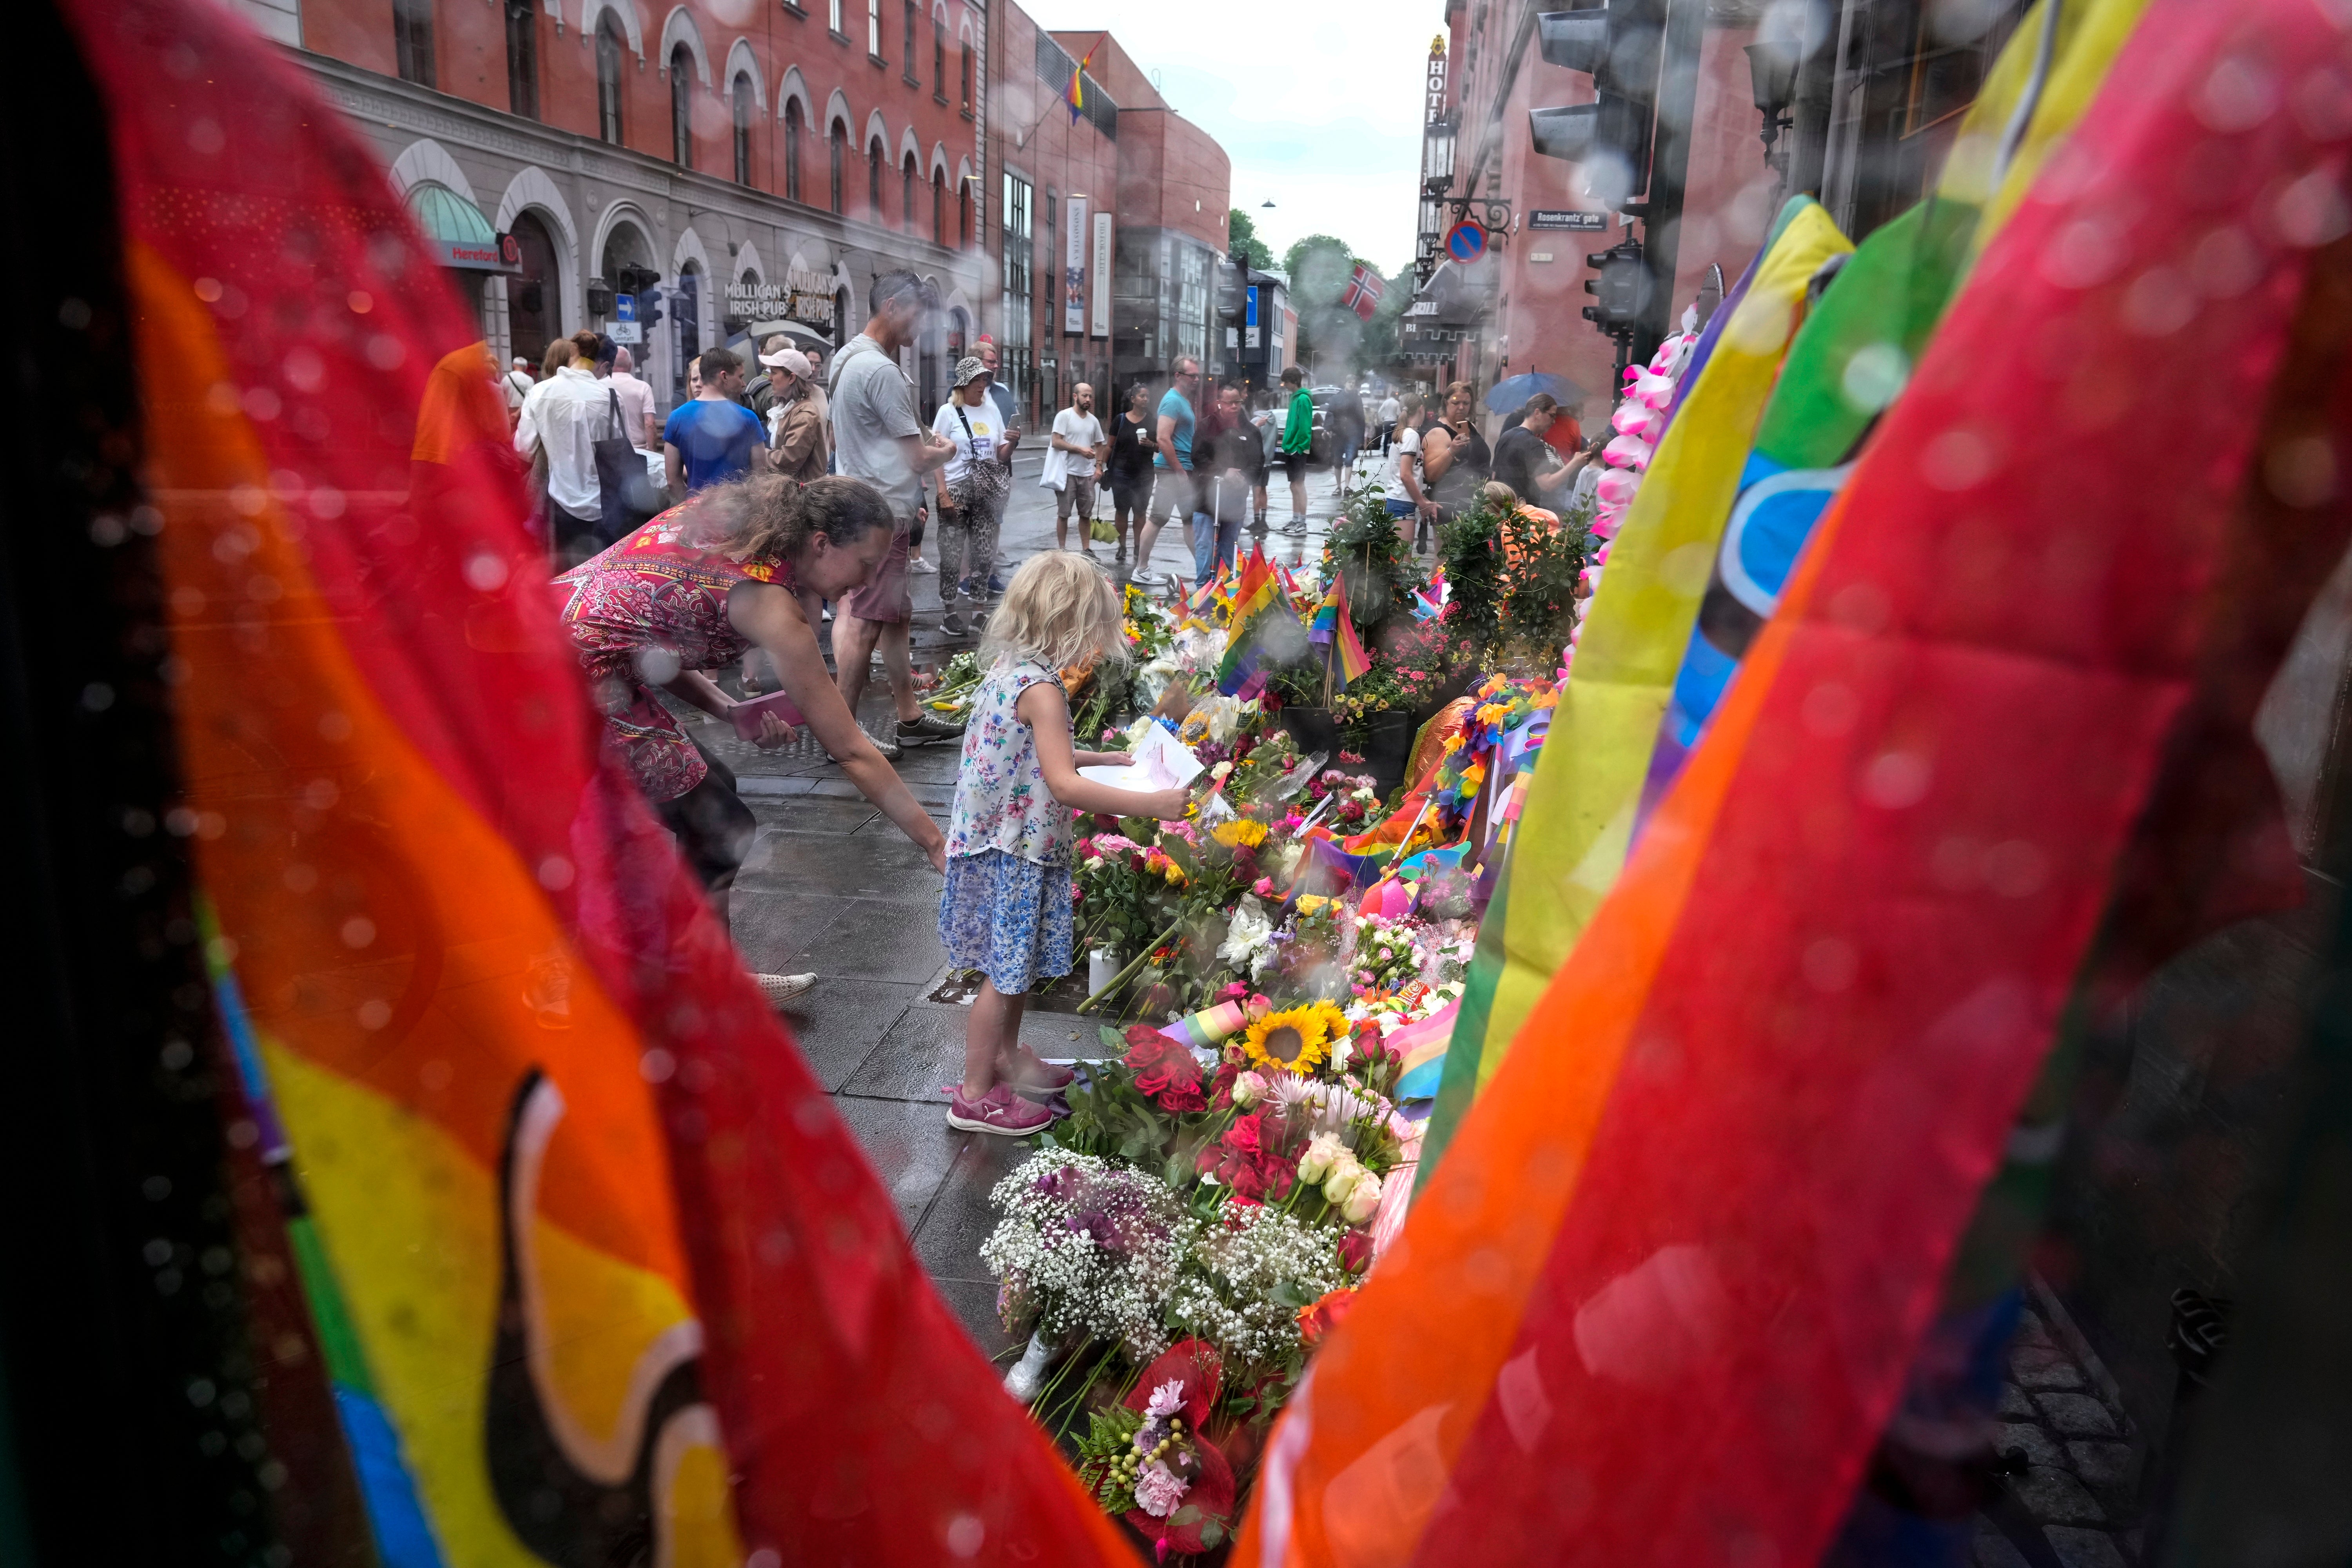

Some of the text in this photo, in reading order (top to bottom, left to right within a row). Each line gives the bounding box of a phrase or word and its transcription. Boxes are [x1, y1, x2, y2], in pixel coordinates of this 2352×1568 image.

[1583, 214, 1599, 225] gate
[452, 247, 498, 262] Hereford
[725, 283, 791, 300] MULLIGAN'S
[730, 300, 788, 316] IRISH PUB
[816, 298, 830, 320] PUB
